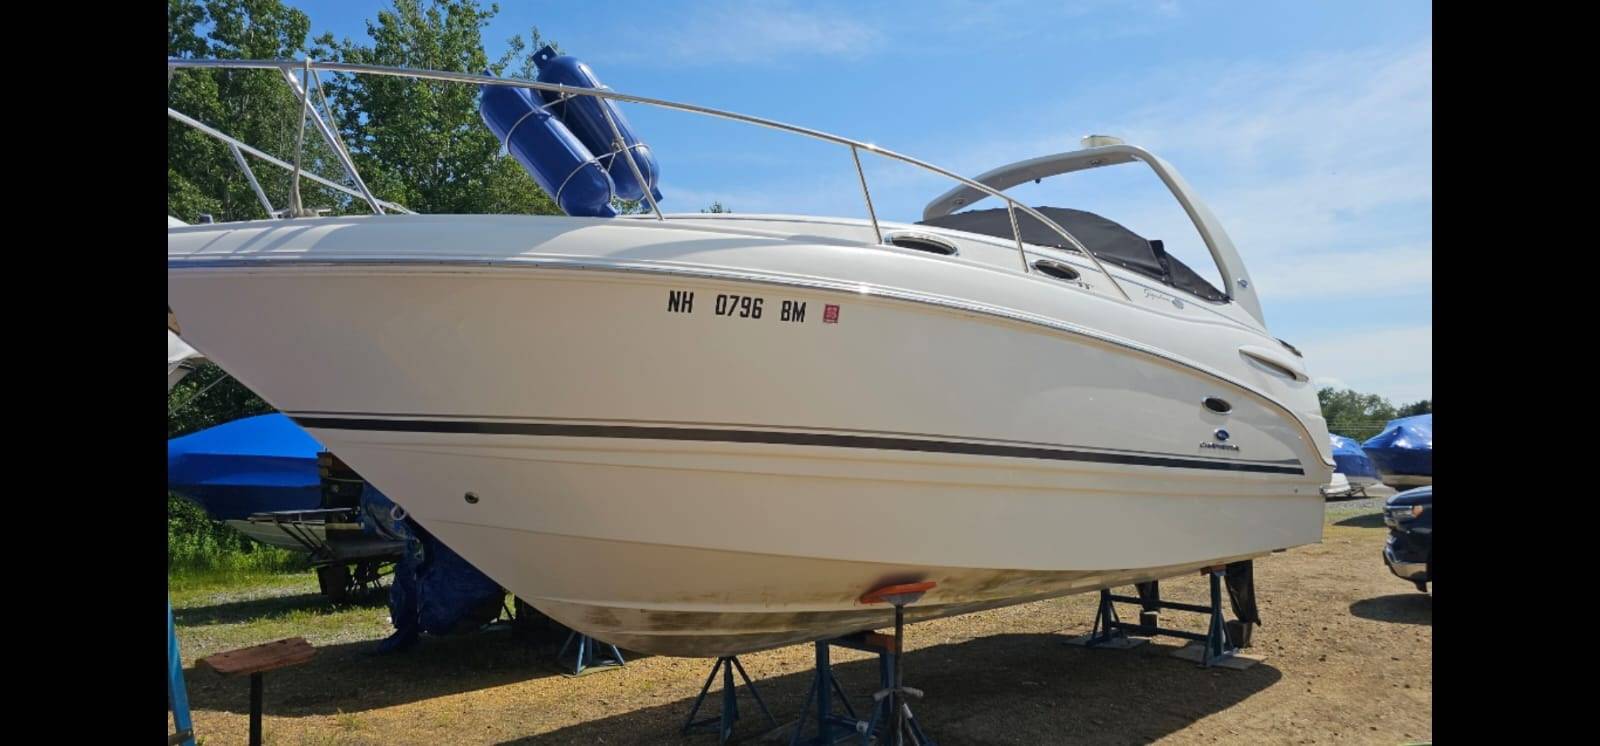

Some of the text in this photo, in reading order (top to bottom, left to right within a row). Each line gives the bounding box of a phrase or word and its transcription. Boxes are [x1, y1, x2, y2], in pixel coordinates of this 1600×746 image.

[667, 290, 694, 313] NH
[715, 294, 764, 319] 0796
[780, 300, 807, 323] BM
